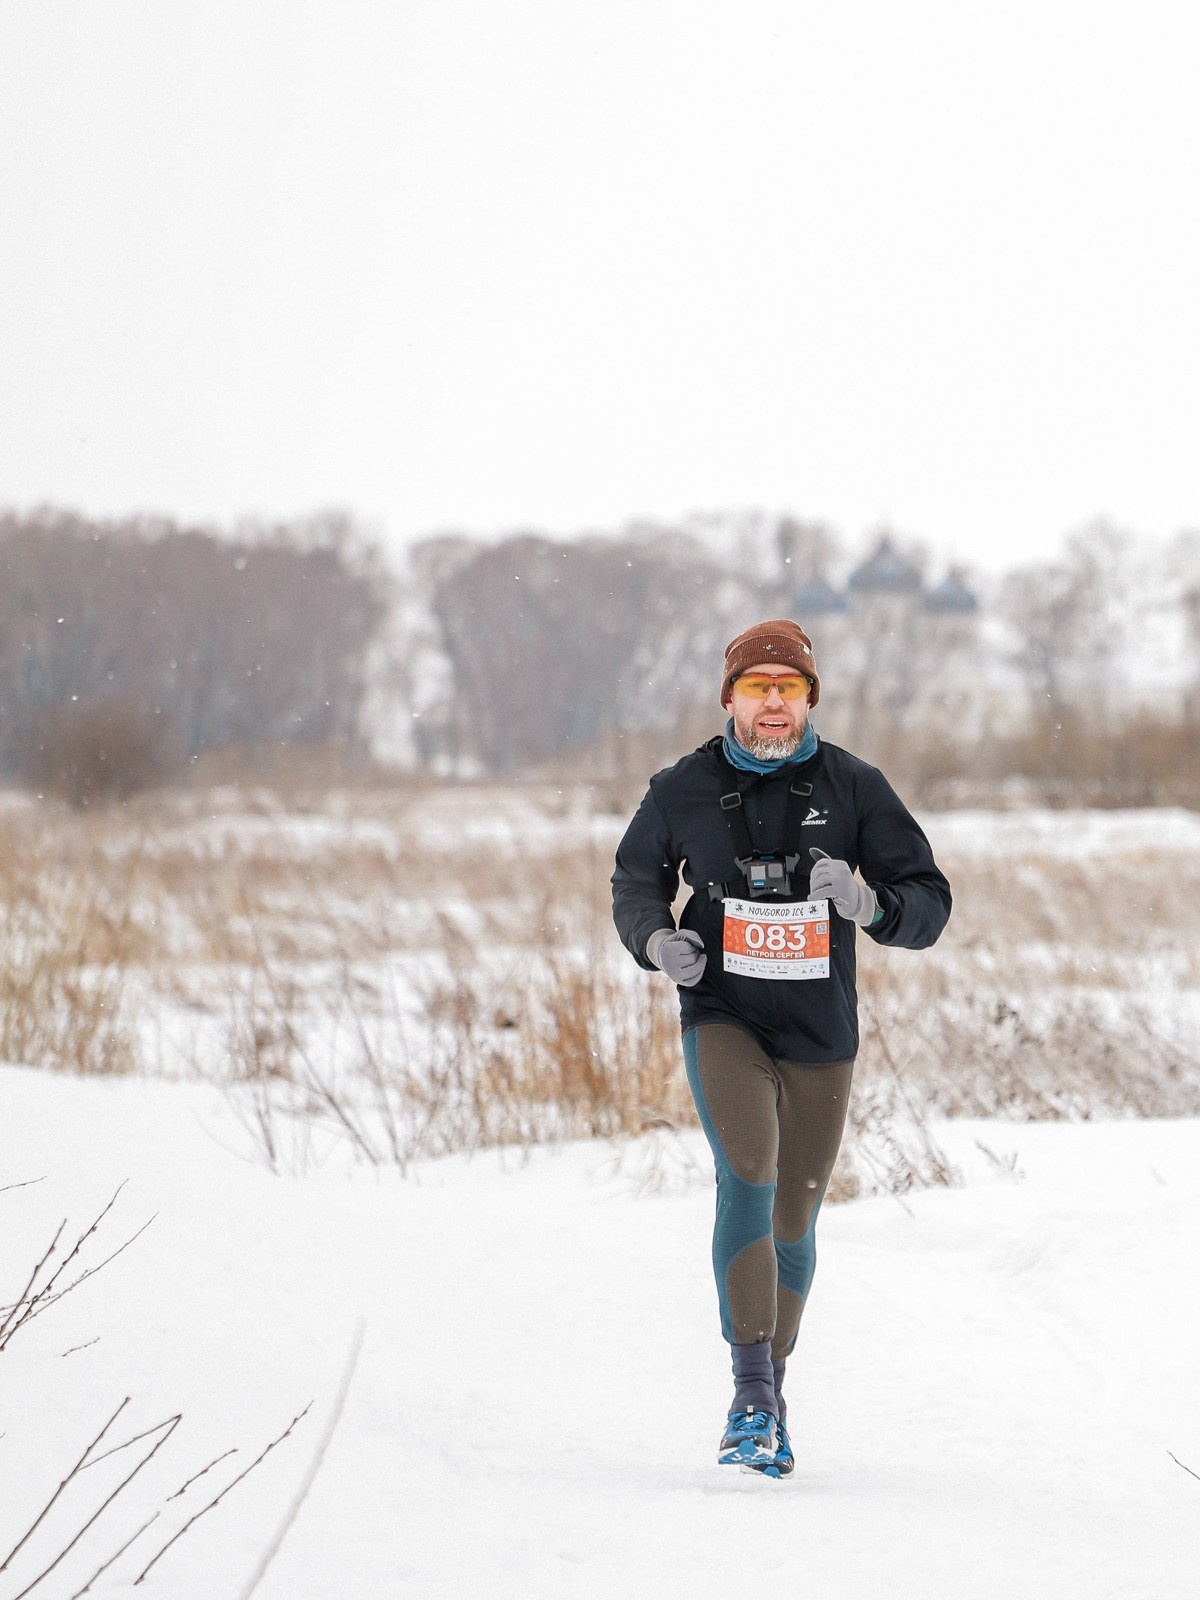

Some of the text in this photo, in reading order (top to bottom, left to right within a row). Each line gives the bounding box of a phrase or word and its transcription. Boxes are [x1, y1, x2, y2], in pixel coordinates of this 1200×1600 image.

[748, 906, 790, 917] NOVGOROD
[792, 907, 804, 917] ICE
[745, 923, 807, 951] 083
[746, 949, 805, 959] ПЕТРОВ СЕРГЕЙ
